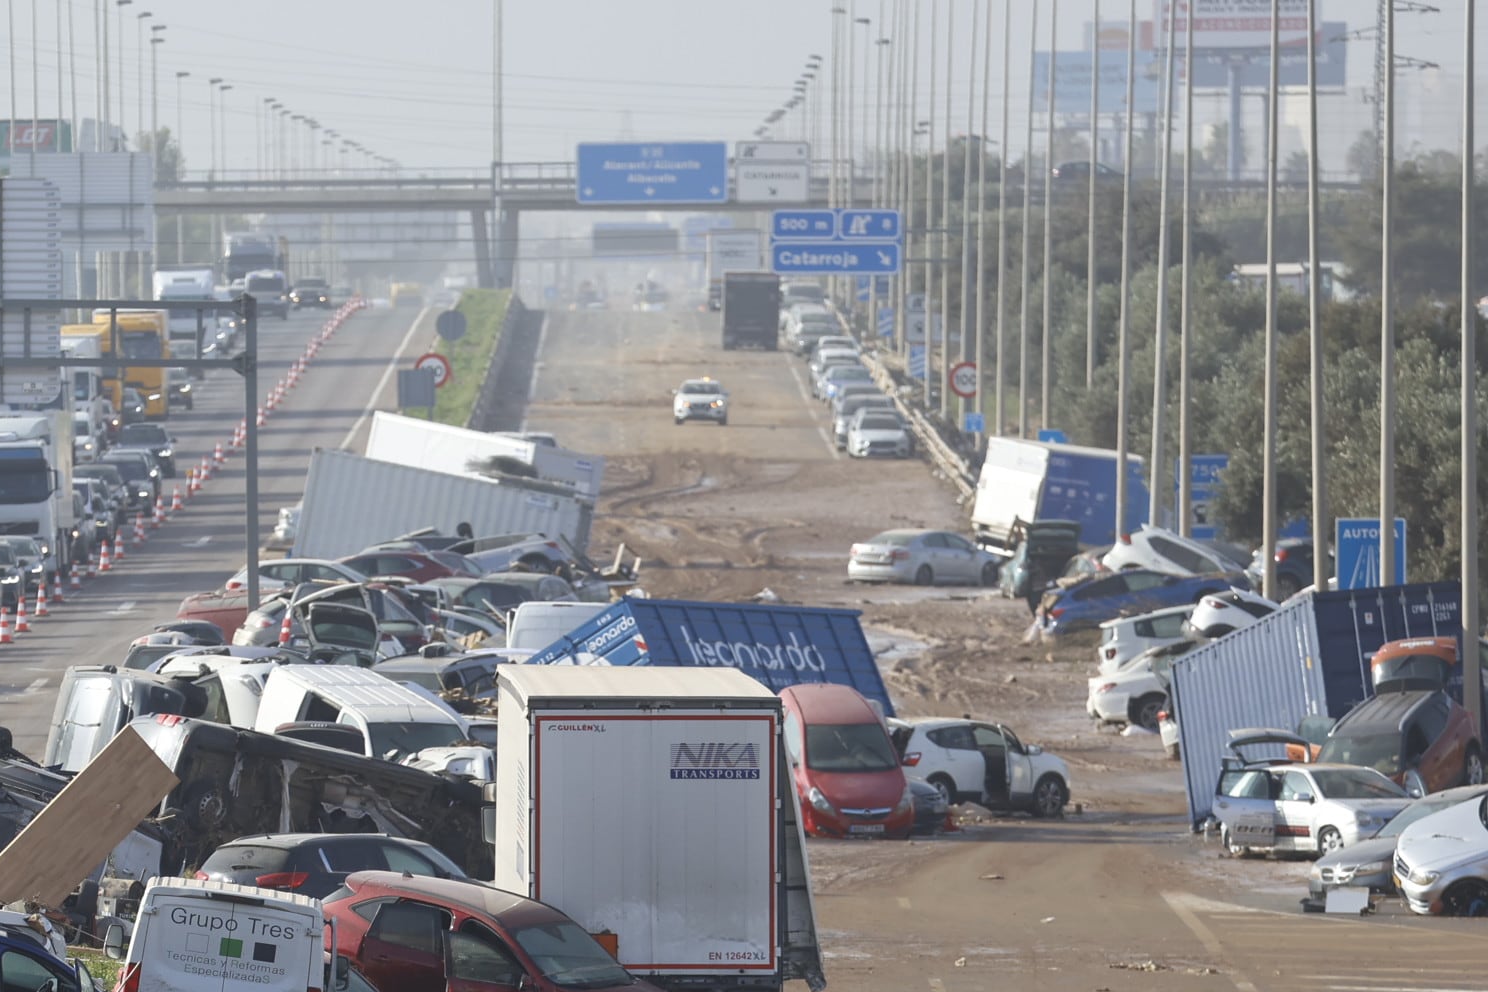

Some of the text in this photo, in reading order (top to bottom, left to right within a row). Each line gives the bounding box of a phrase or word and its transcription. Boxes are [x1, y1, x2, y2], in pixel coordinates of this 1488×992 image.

[779, 218, 828, 230] 500 m
[779, 251, 858, 268] Catarroja
[1342, 526, 1400, 539] AUTOA
[673, 742, 760, 768] NIKA
[673, 769, 760, 779] TRANSPORTS
[170, 907, 295, 940] Grupo Tres
[167, 950, 285, 976] Tecnicas y Reformas
[708, 952, 722, 960] EN
